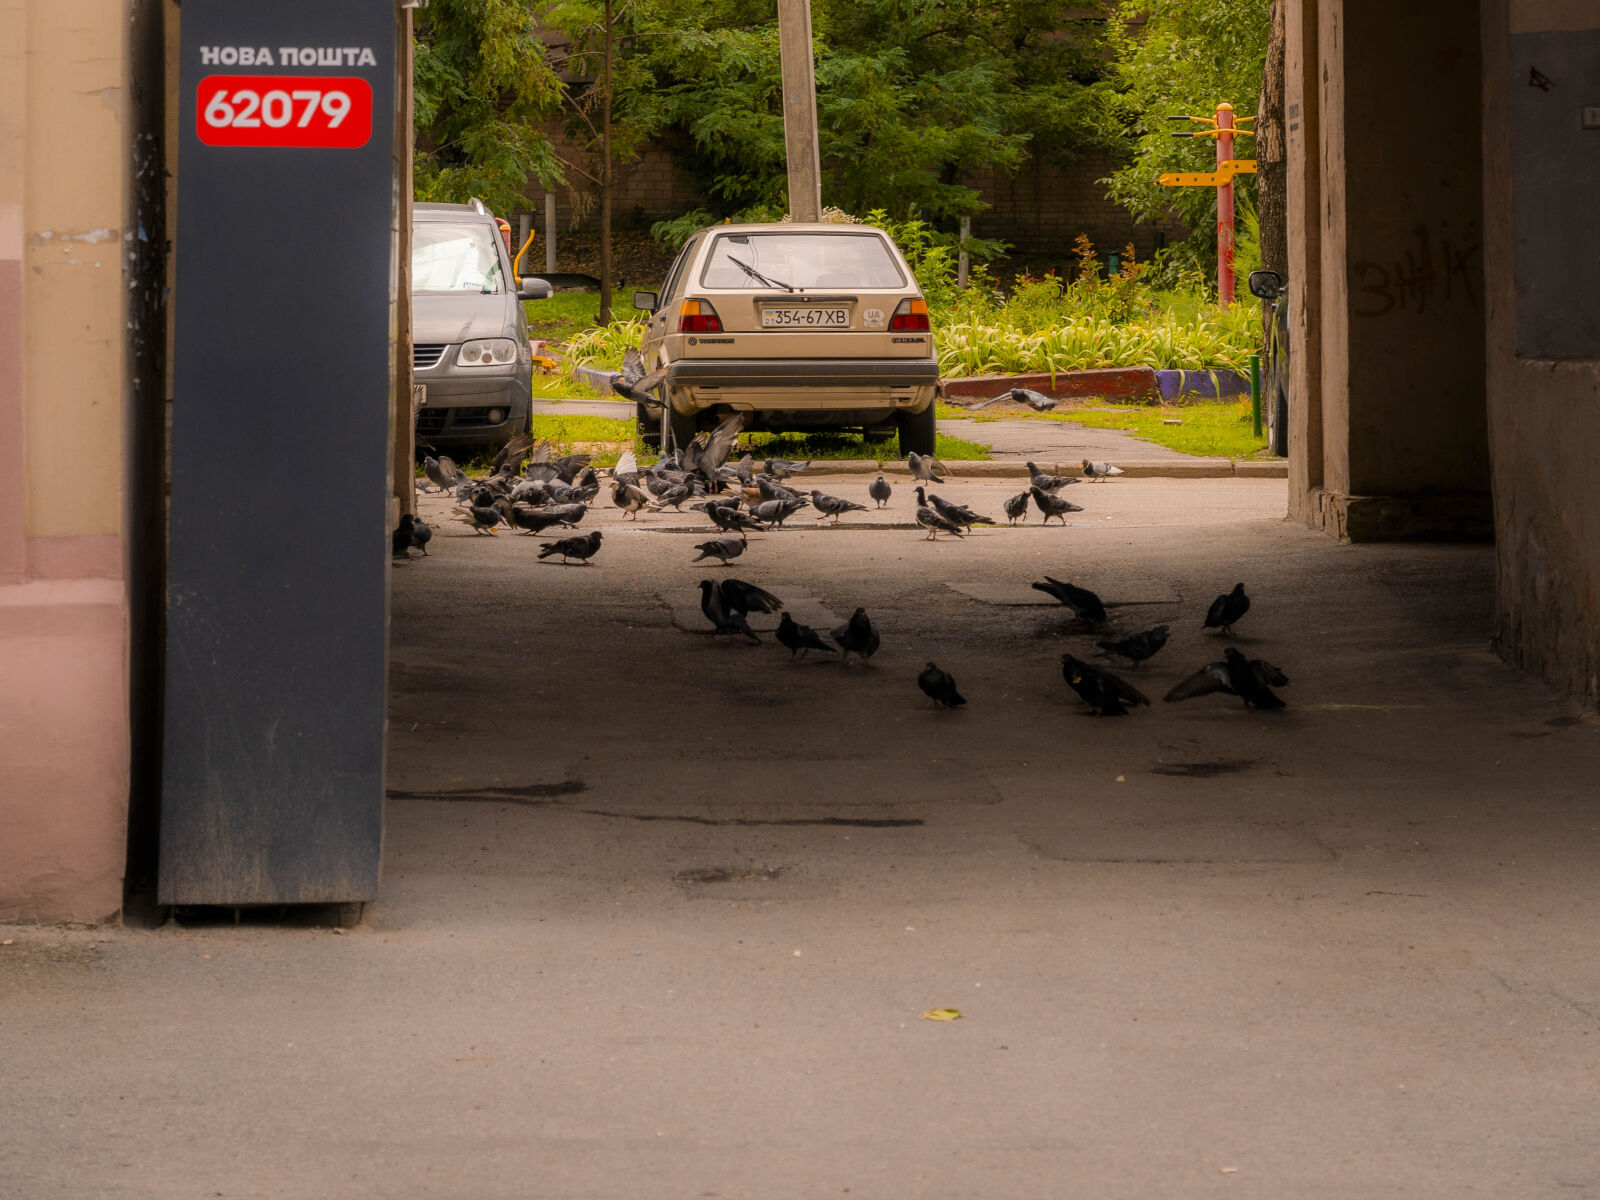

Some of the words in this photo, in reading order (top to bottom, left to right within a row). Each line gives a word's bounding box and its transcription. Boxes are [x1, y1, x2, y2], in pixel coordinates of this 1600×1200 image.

[199, 46, 275, 66] НОВА
[278, 47, 378, 67] ПОШТА
[204, 89, 352, 129] 62079
[867, 310, 881, 319] UA
